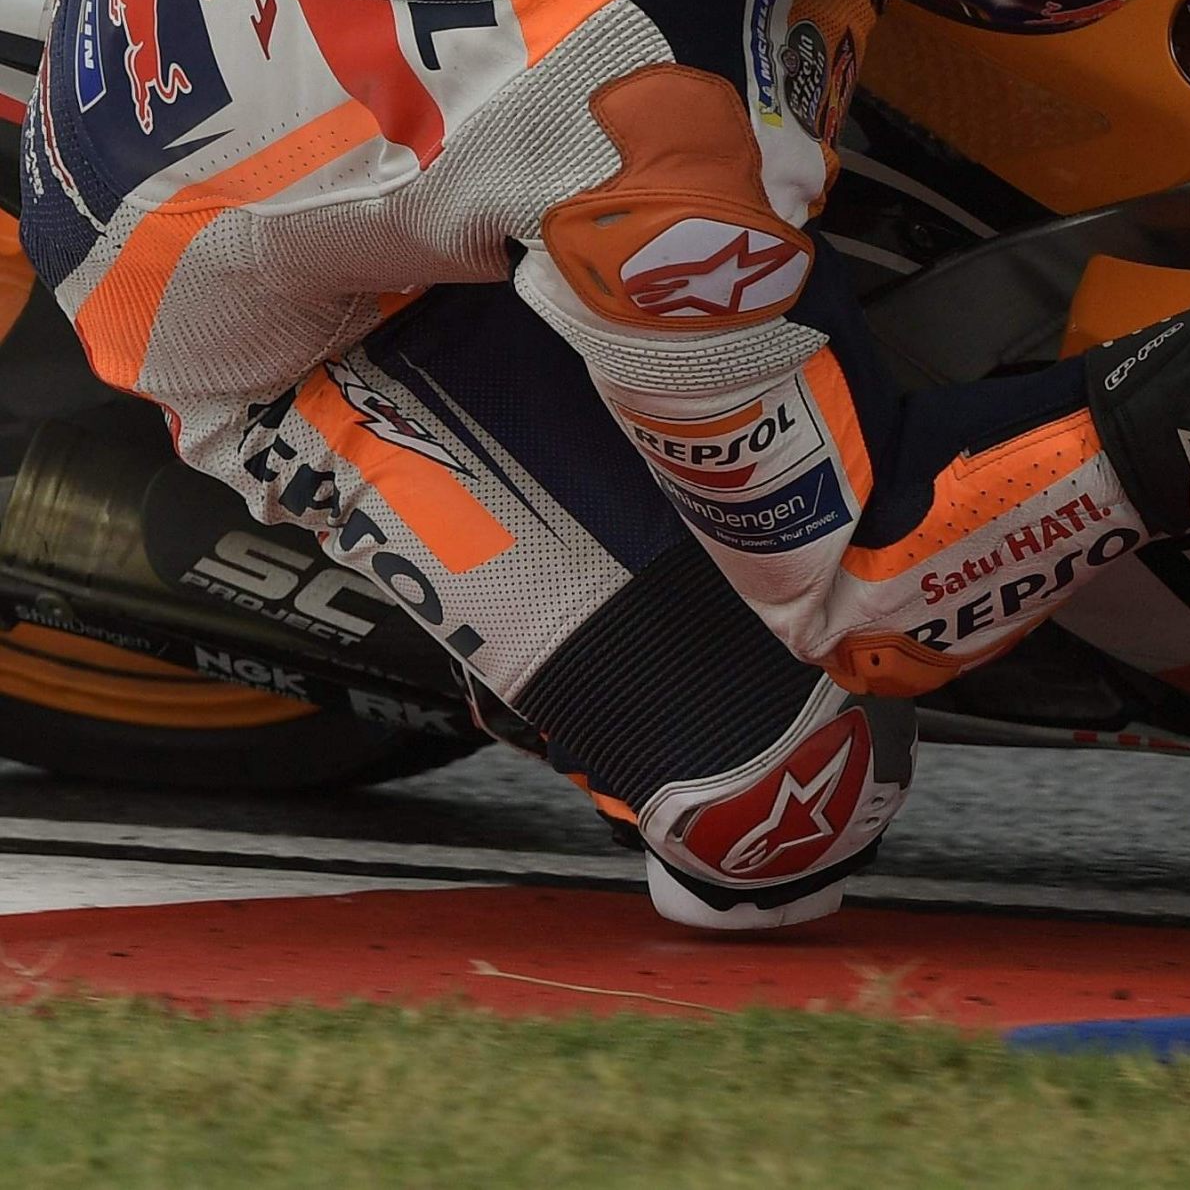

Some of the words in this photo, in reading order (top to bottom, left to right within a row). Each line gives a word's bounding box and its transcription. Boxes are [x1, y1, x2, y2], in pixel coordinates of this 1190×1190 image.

[634, 402, 797, 467] REPSOL
[779, 526, 804, 544] Your
[804, 510, 839, 536] power.
[920, 542, 1006, 607] Satu
[1005, 491, 1113, 563] HATI.
[179, 570, 368, 648] PROJECT
[193, 529, 400, 638] SC
[903, 526, 1141, 654] REPSO
[194, 644, 307, 696] NGK
[348, 688, 459, 737] RK
